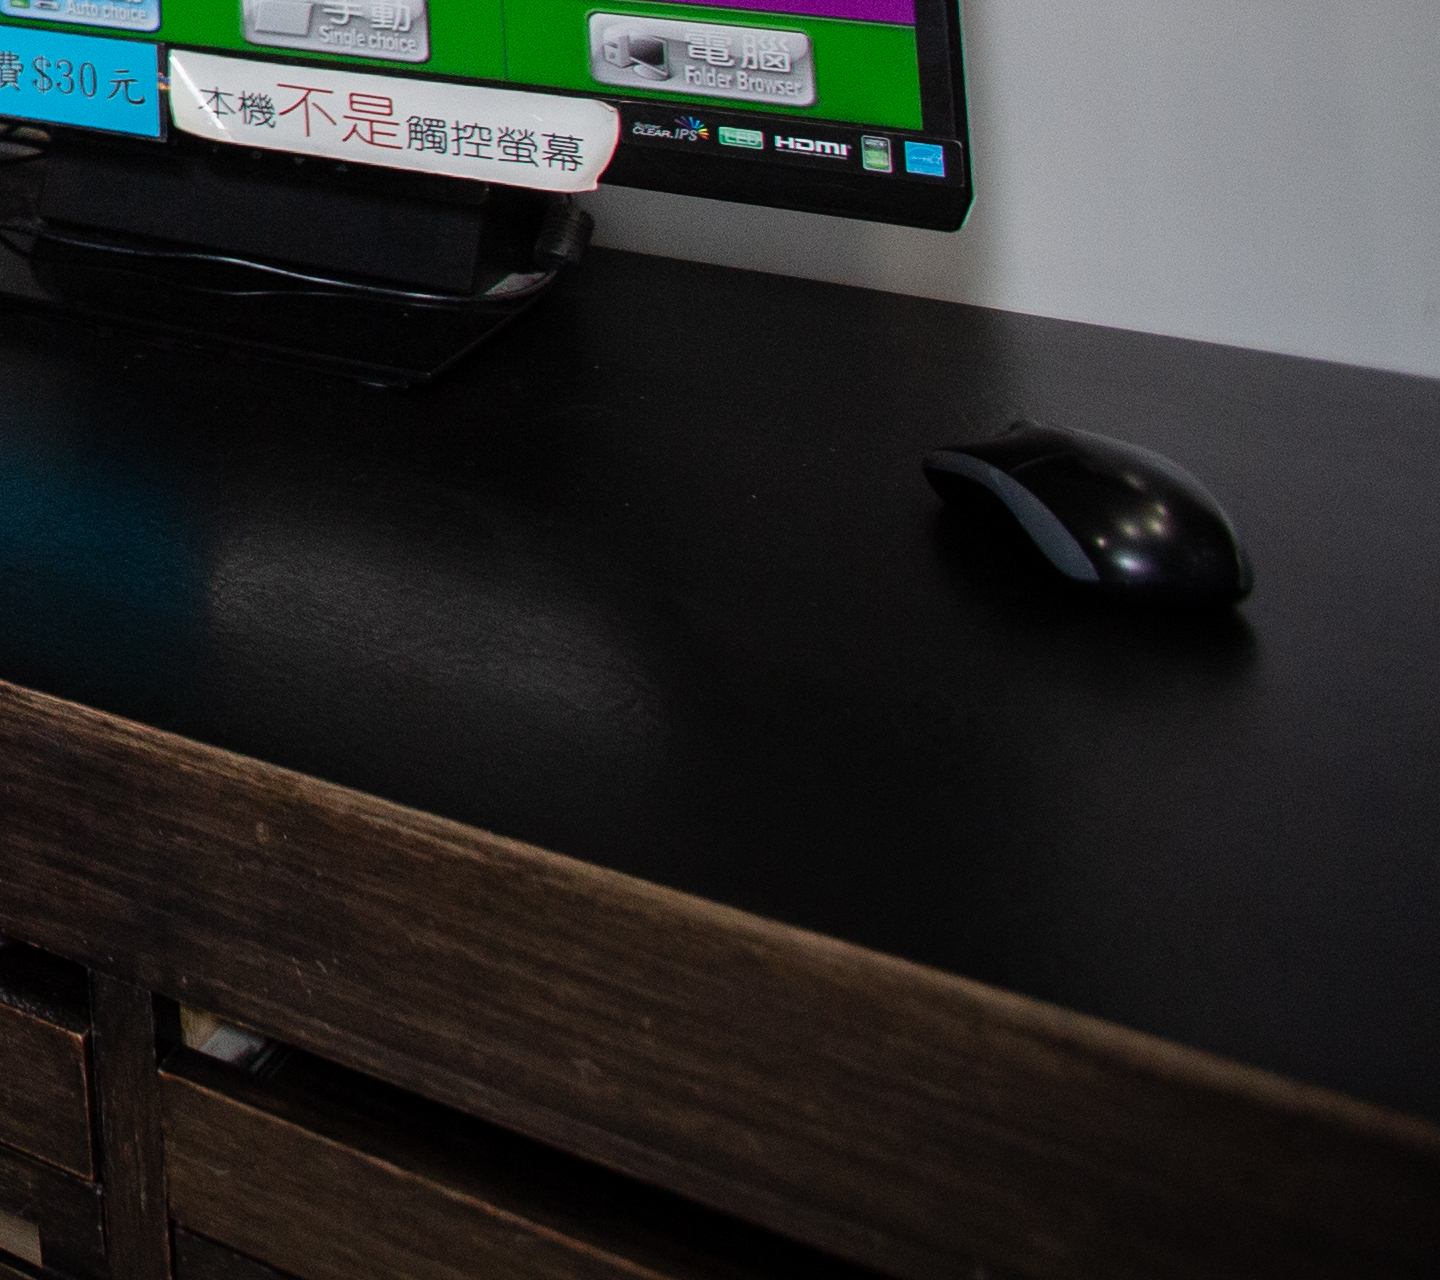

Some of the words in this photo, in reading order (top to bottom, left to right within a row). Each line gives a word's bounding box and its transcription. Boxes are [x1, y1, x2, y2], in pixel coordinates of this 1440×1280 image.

[97, 1, 147, 22] choice
[319, 25, 364, 48] Single
[367, 29, 418, 54] choice
[684, 30, 791, 73] 電腦
[684, 65, 733, 91] Folder
[737, 70, 803, 97] Browser
[199, 82, 584, 173] 本機不是觸控螢幕
[775, 135, 848, 156] HDMI
